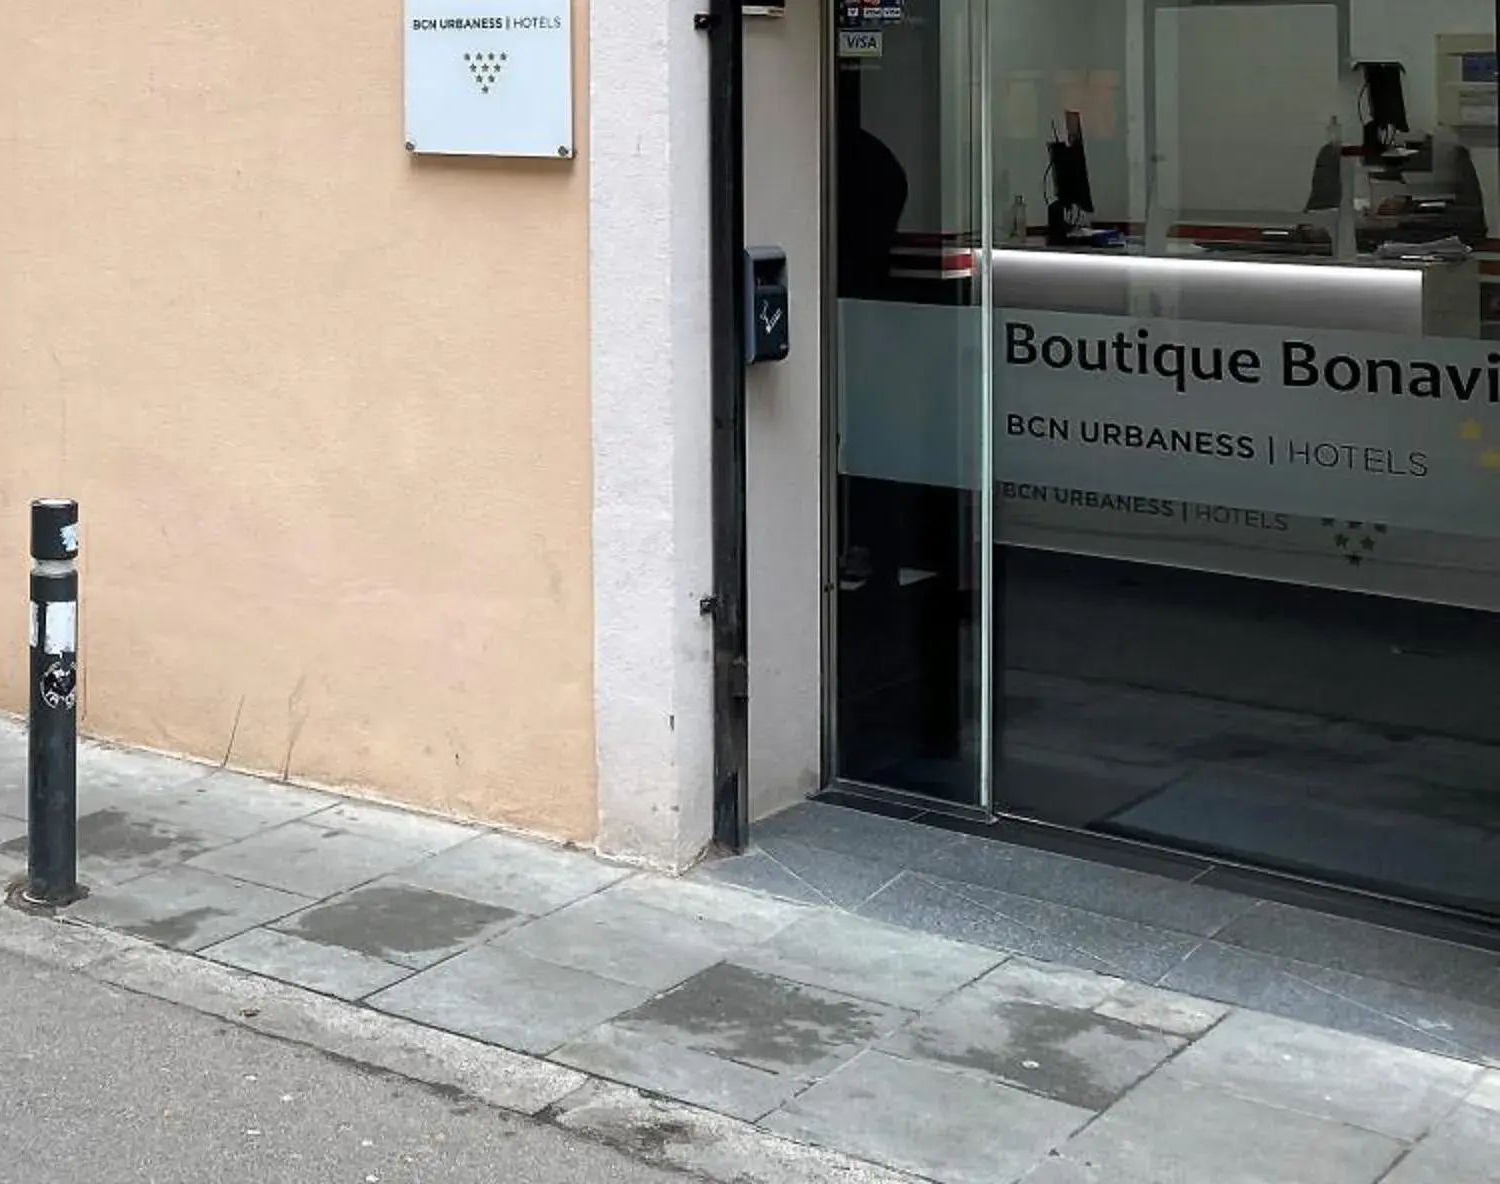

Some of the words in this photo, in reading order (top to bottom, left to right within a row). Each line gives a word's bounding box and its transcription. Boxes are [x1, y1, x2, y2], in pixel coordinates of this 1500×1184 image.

[412, 18, 437, 31] BCN
[438, 16, 504, 30] URBANESS
[513, 15, 562, 30] HOTELS
[846, 35, 878, 49] VISA
[1005, 321, 1262, 393] Boutique
[1282, 340, 1500, 404] Bonavi
[1006, 413, 1069, 442] BCN
[1080, 420, 1256, 460] URBANESS
[1288, 440, 1429, 478] HOTELS
[1002, 480, 1048, 503] BCN
[1054, 486, 1175, 518] URBANESS
[1195, 503, 1290, 532] HOTELS
